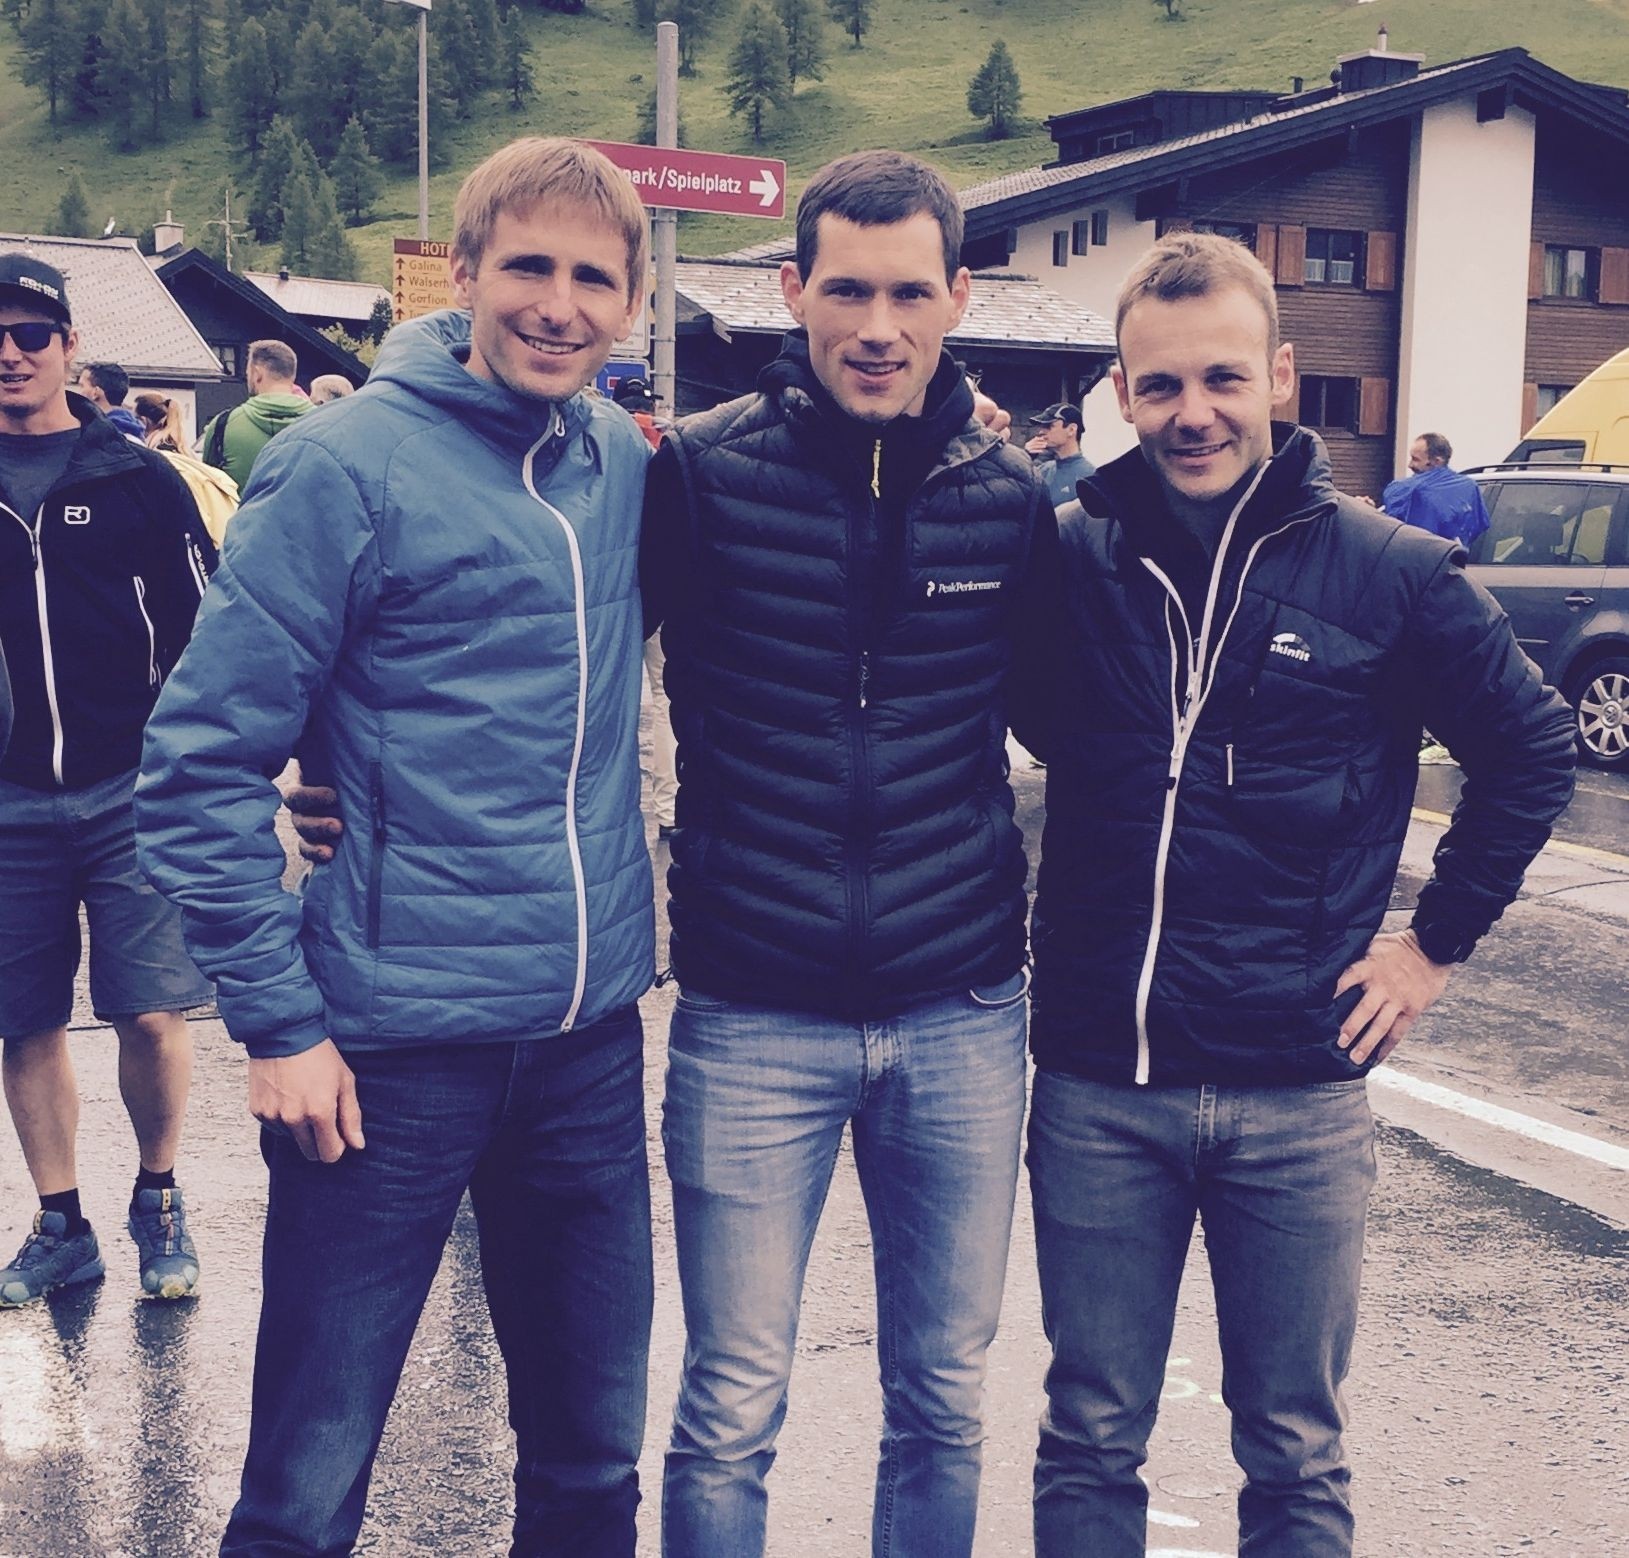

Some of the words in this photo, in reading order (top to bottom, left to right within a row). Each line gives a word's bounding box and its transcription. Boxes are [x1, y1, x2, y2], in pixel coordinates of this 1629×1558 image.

[420, 242, 450, 256] HOT
[409, 260, 442, 271] Galina
[409, 293, 447, 304] Gorfion
[1270, 643, 1310, 661] skinfit
